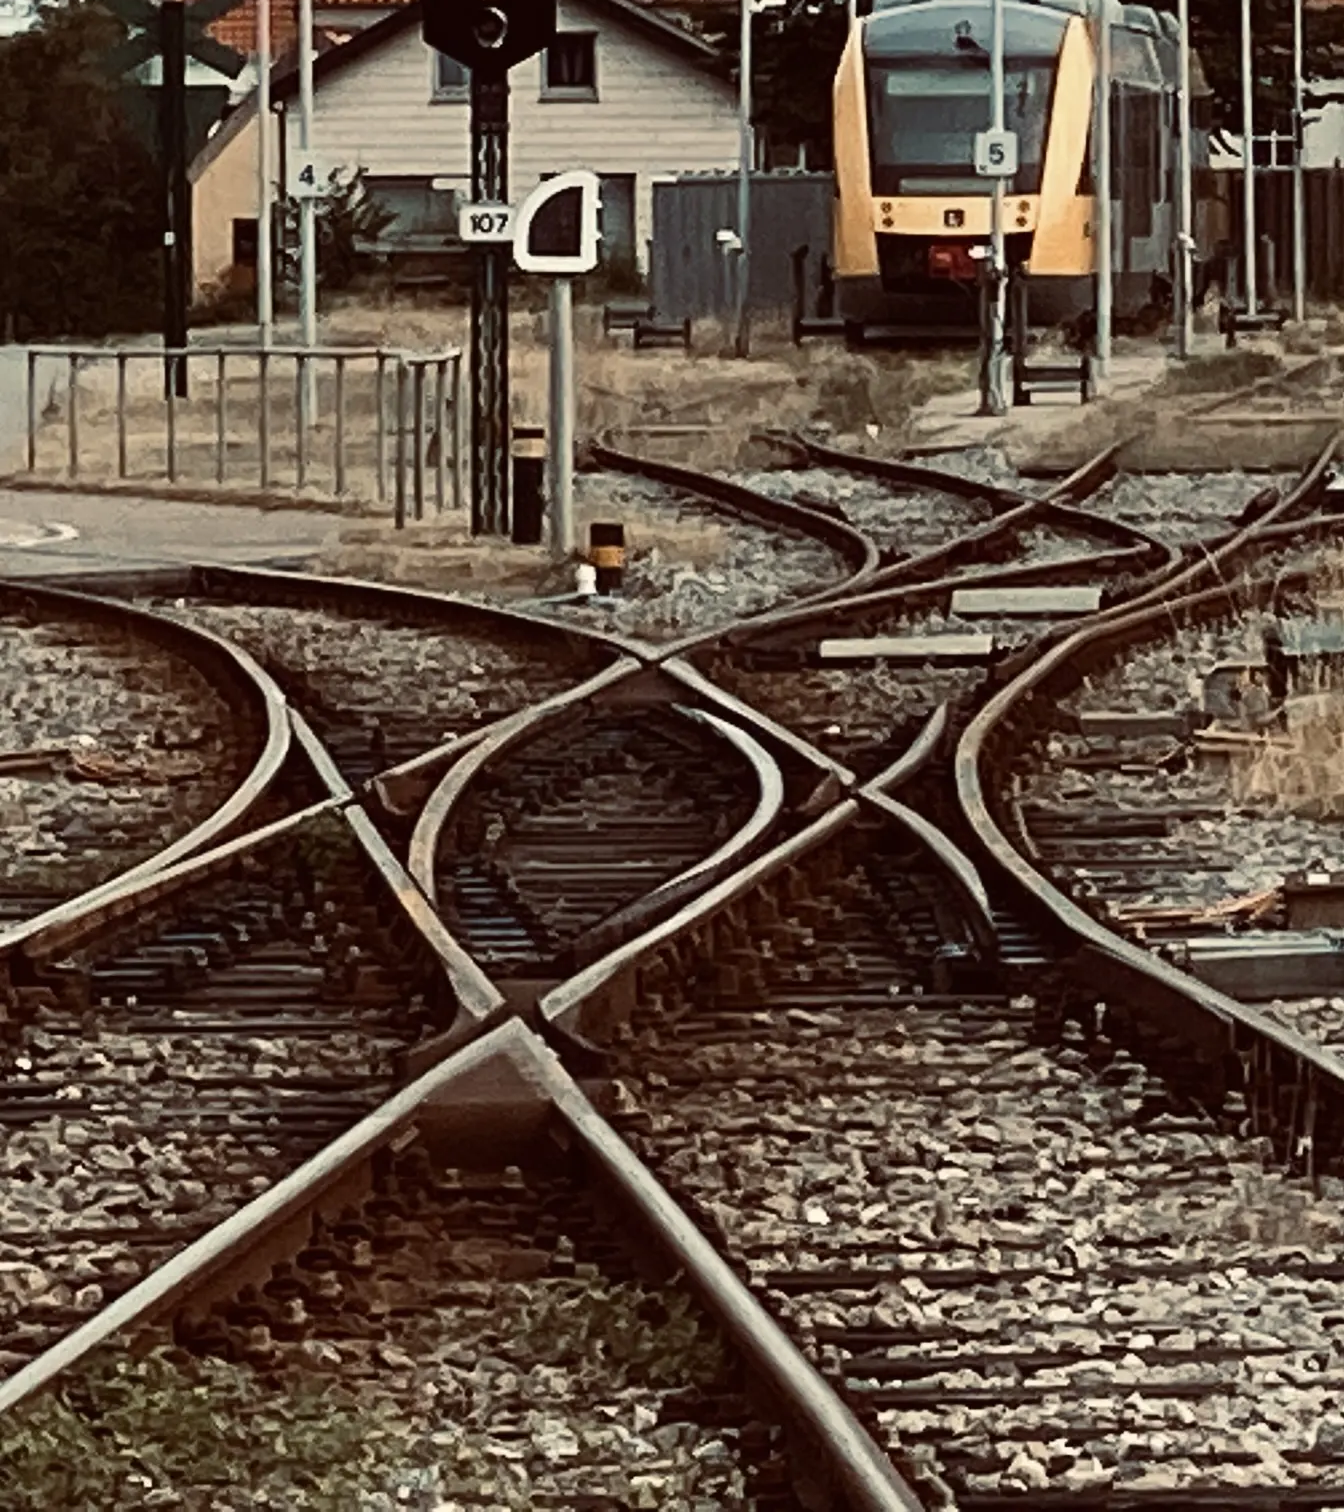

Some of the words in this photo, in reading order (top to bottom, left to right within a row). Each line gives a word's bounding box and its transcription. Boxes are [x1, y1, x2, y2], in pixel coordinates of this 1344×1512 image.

[989, 143, 1005, 165] 5
[299, 165, 315, 185] 4
[470, 213, 509, 233] 107
